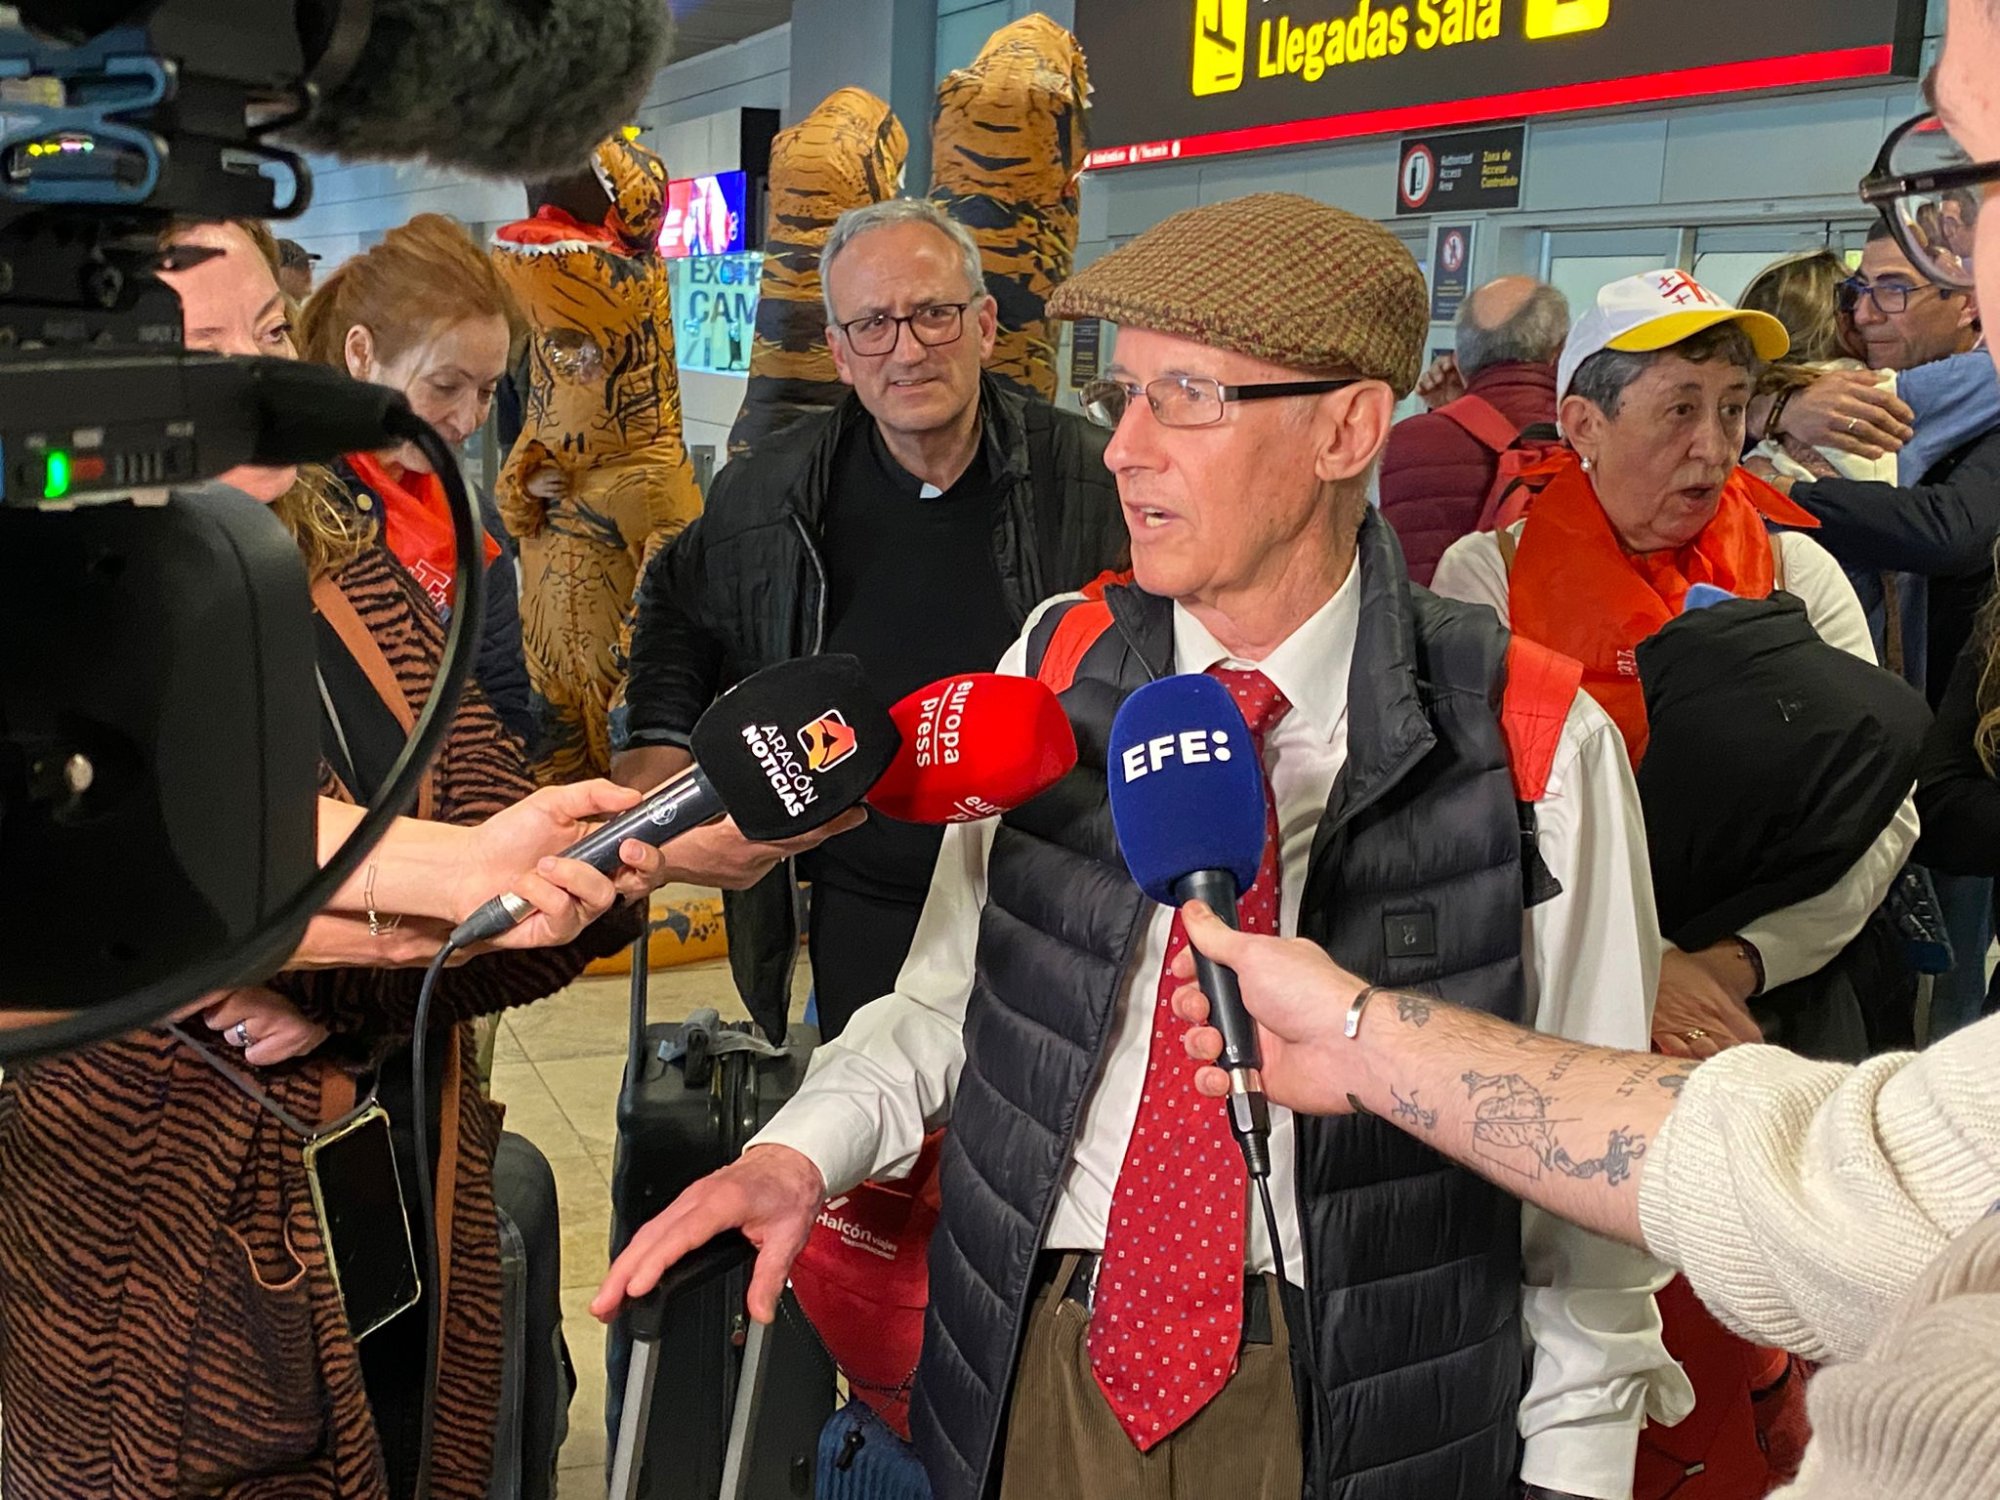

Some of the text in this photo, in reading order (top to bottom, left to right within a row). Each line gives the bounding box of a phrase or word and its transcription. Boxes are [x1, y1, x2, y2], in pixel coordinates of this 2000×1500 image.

[1258, 0, 1500, 82] Llegadas Sala
[916, 697, 940, 767] press
[939, 681, 974, 764] europa
[741, 724, 805, 817] NOTICIAS
[760, 725, 819, 805] ARAGÓN
[815, 1212, 872, 1243] Halcón
